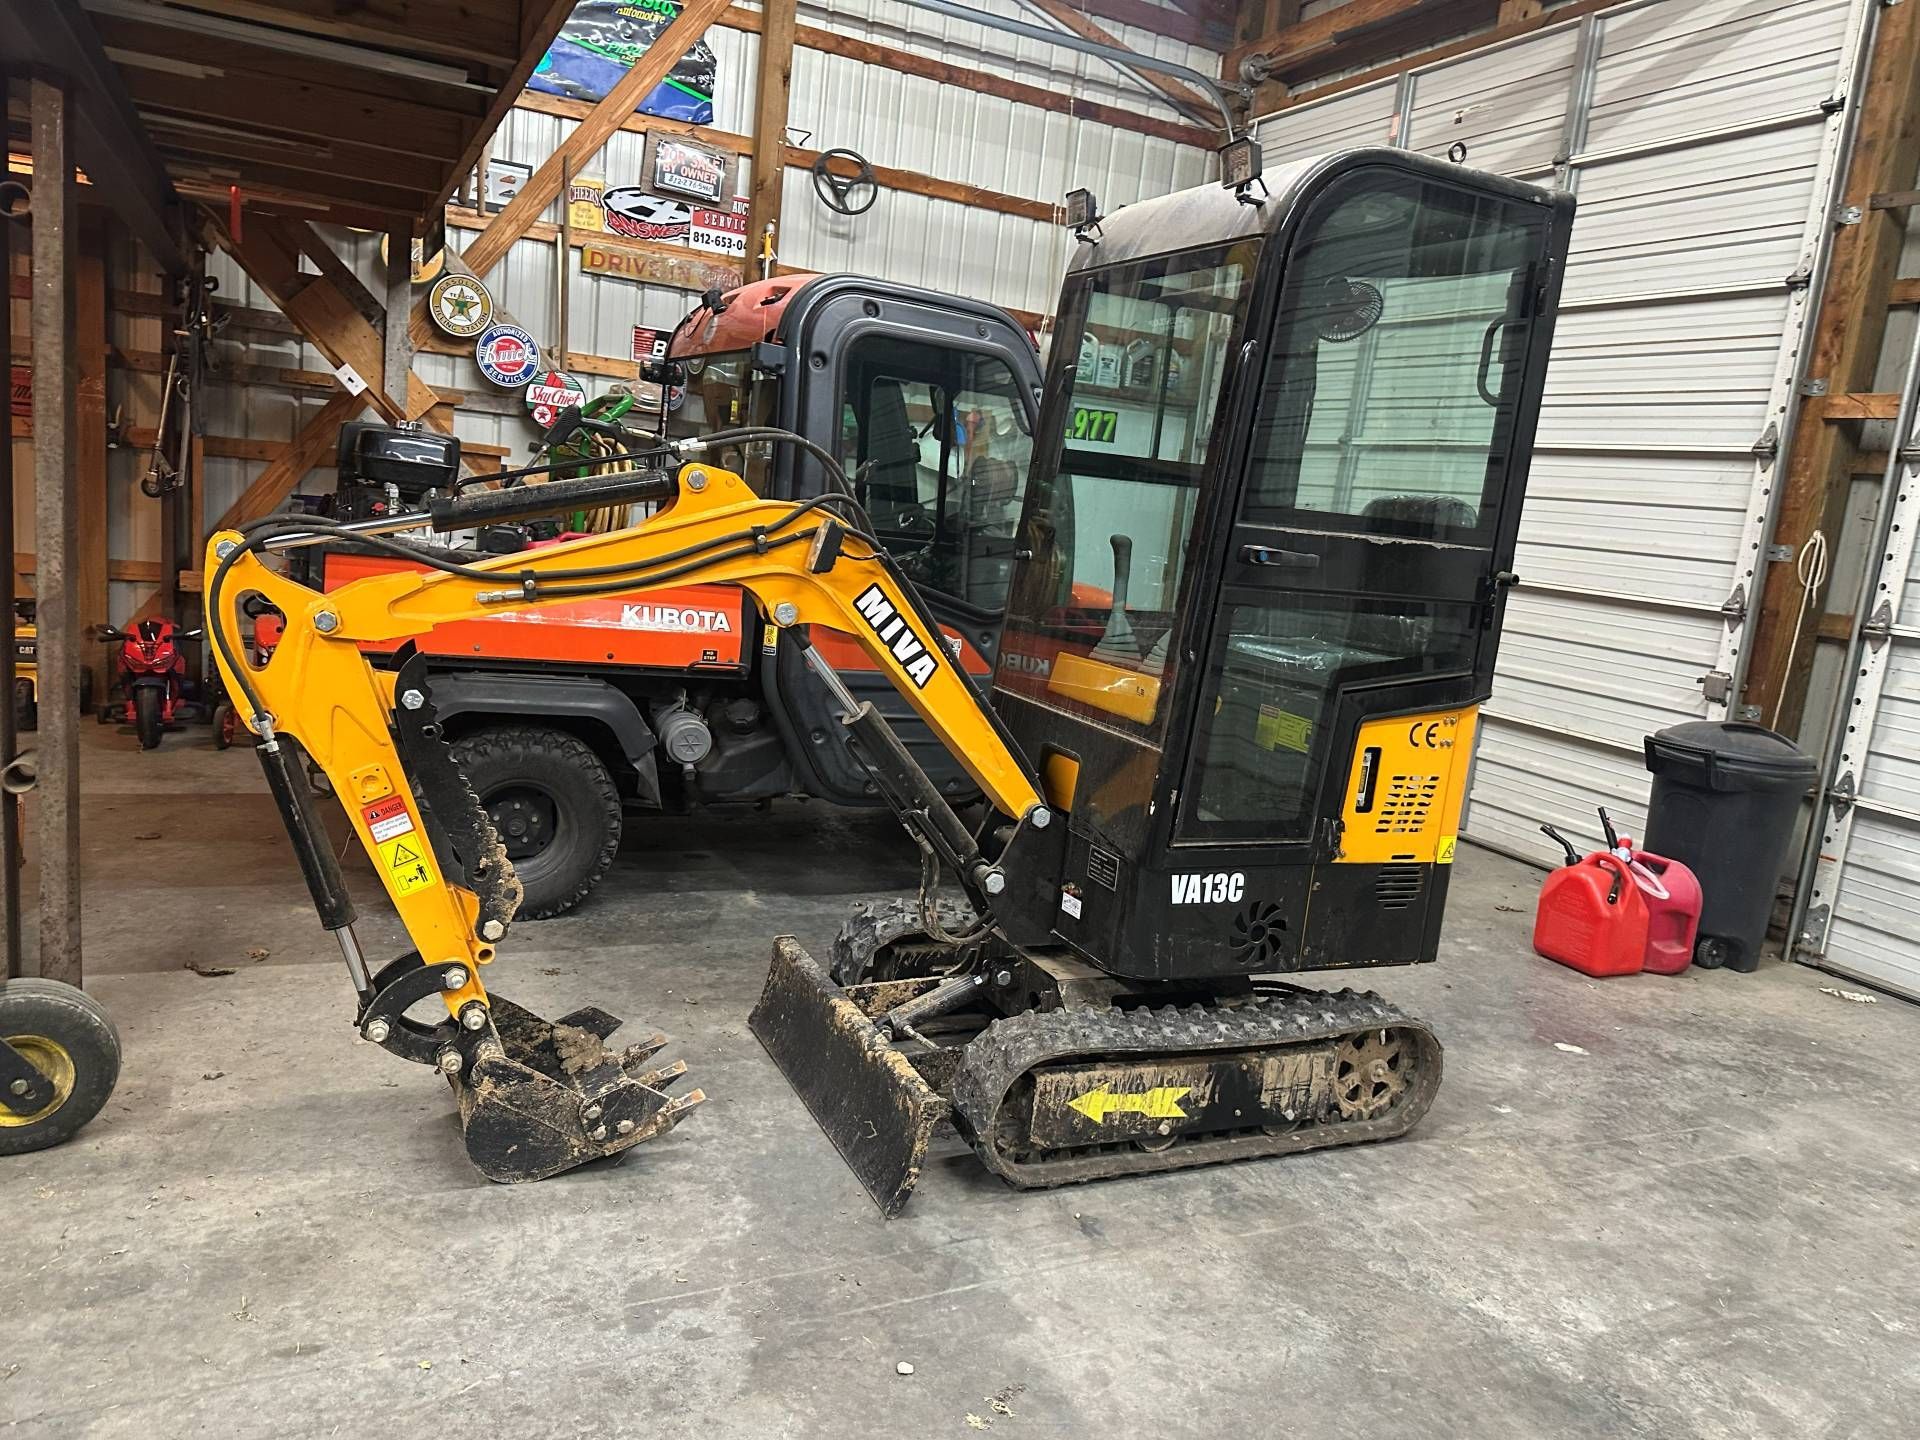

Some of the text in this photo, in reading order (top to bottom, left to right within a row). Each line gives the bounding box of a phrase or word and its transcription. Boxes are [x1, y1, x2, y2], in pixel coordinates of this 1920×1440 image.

[615, 7, 666, 24] Automotive
[662, 161, 718, 185] BY OWNER
[690, 154, 720, 172] SALE
[704, 212, 746, 231] SERVIC
[434, 305, 457, 331] FILLING
[460, 312, 488, 332] STATION
[492, 328, 529, 343] AUTHORIZED
[483, 341, 537, 365] Buick
[487, 367, 526, 383] SERVICE
[531, 386, 582, 405] Sky Chief
[621, 604, 731, 632] KUBOTA
[855, 585, 936, 688] MIVA
[1409, 721, 1440, 748] CE
[380, 801, 404, 815] DANGER
[1171, 871, 1245, 905] VA13C
